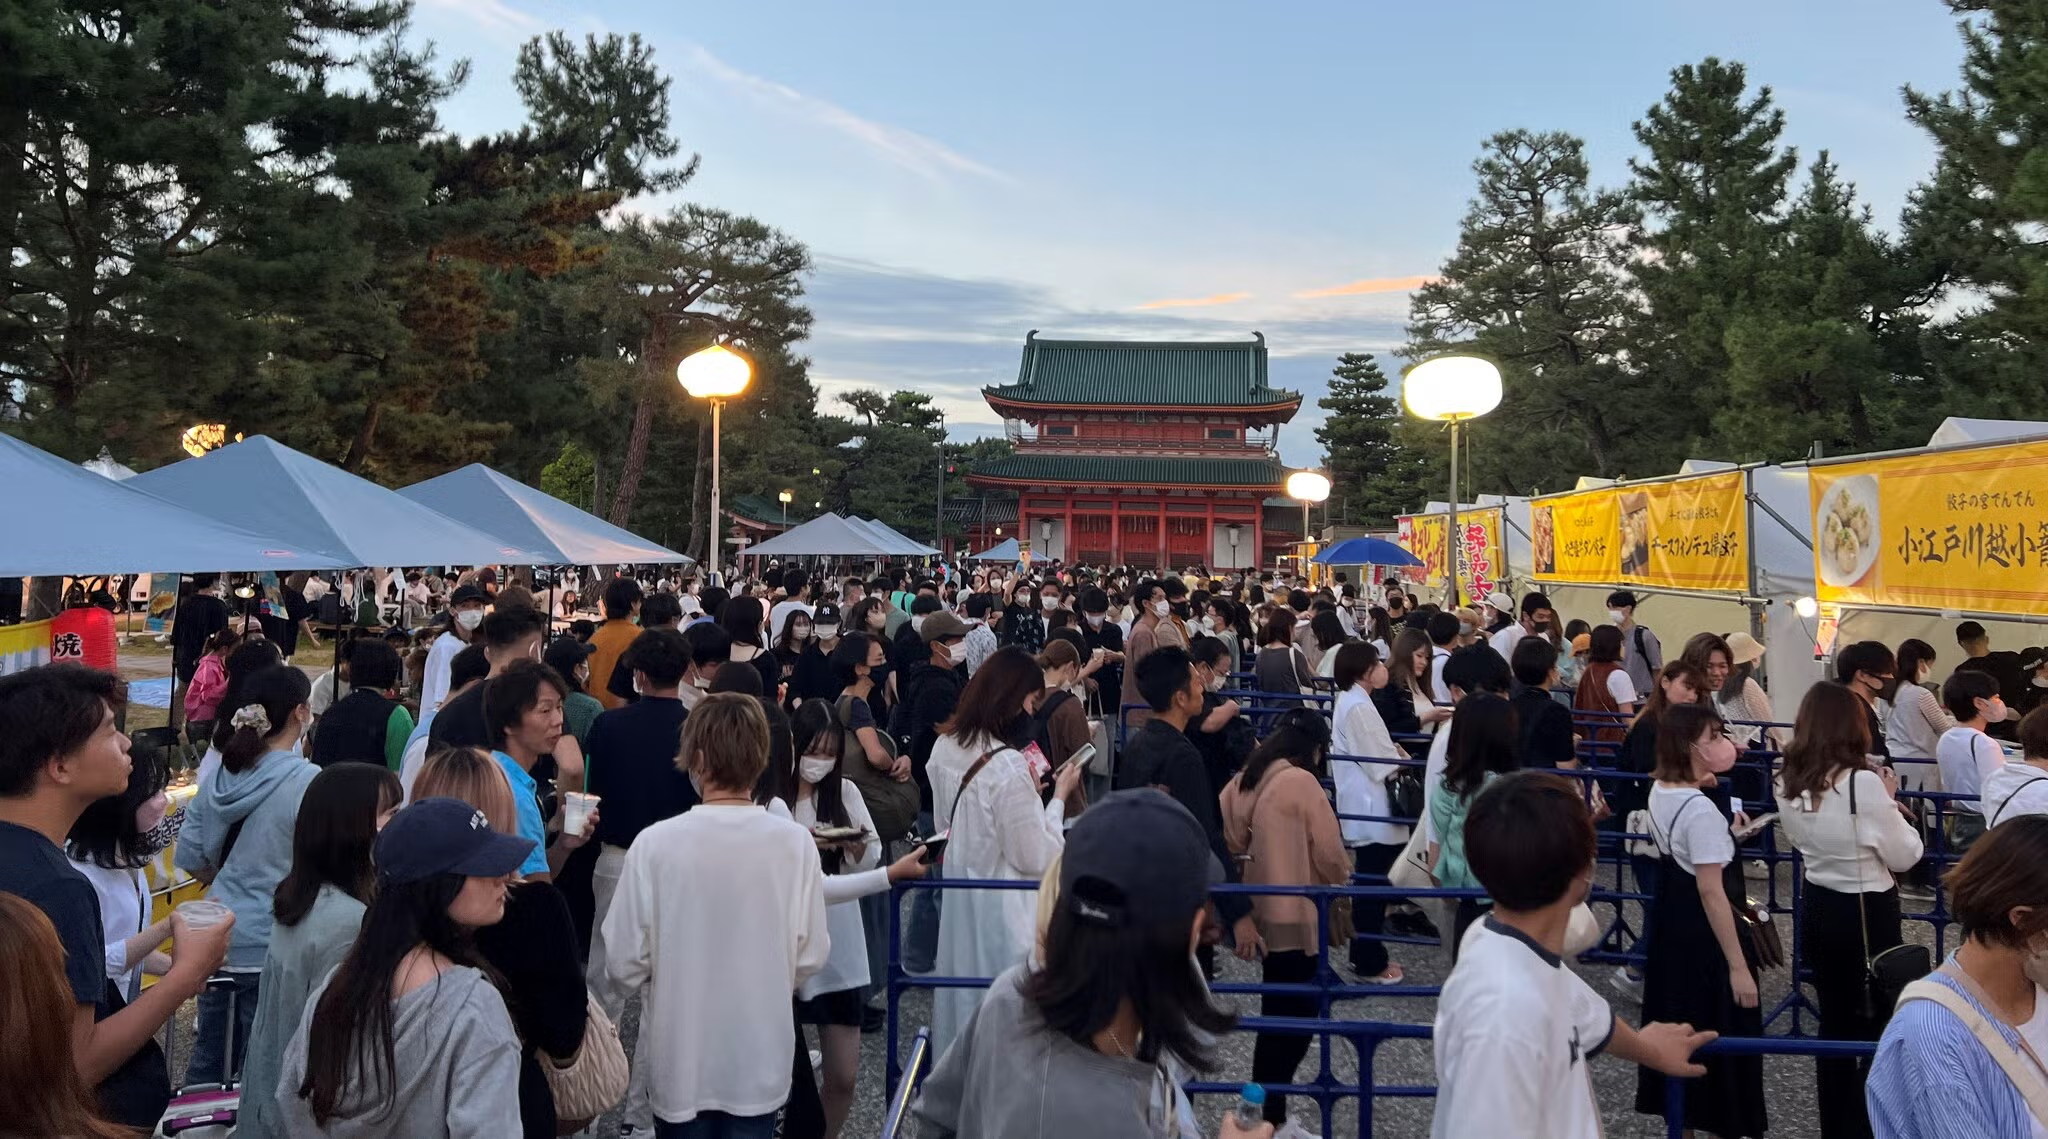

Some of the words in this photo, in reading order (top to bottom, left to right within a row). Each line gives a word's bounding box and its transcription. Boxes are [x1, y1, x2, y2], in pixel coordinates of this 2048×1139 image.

[1946, 490, 2036, 511] 餃子の宮でんでん
[1466, 523, 1496, 604] 絶品ホ
[53, 632, 82, 658] 焼
